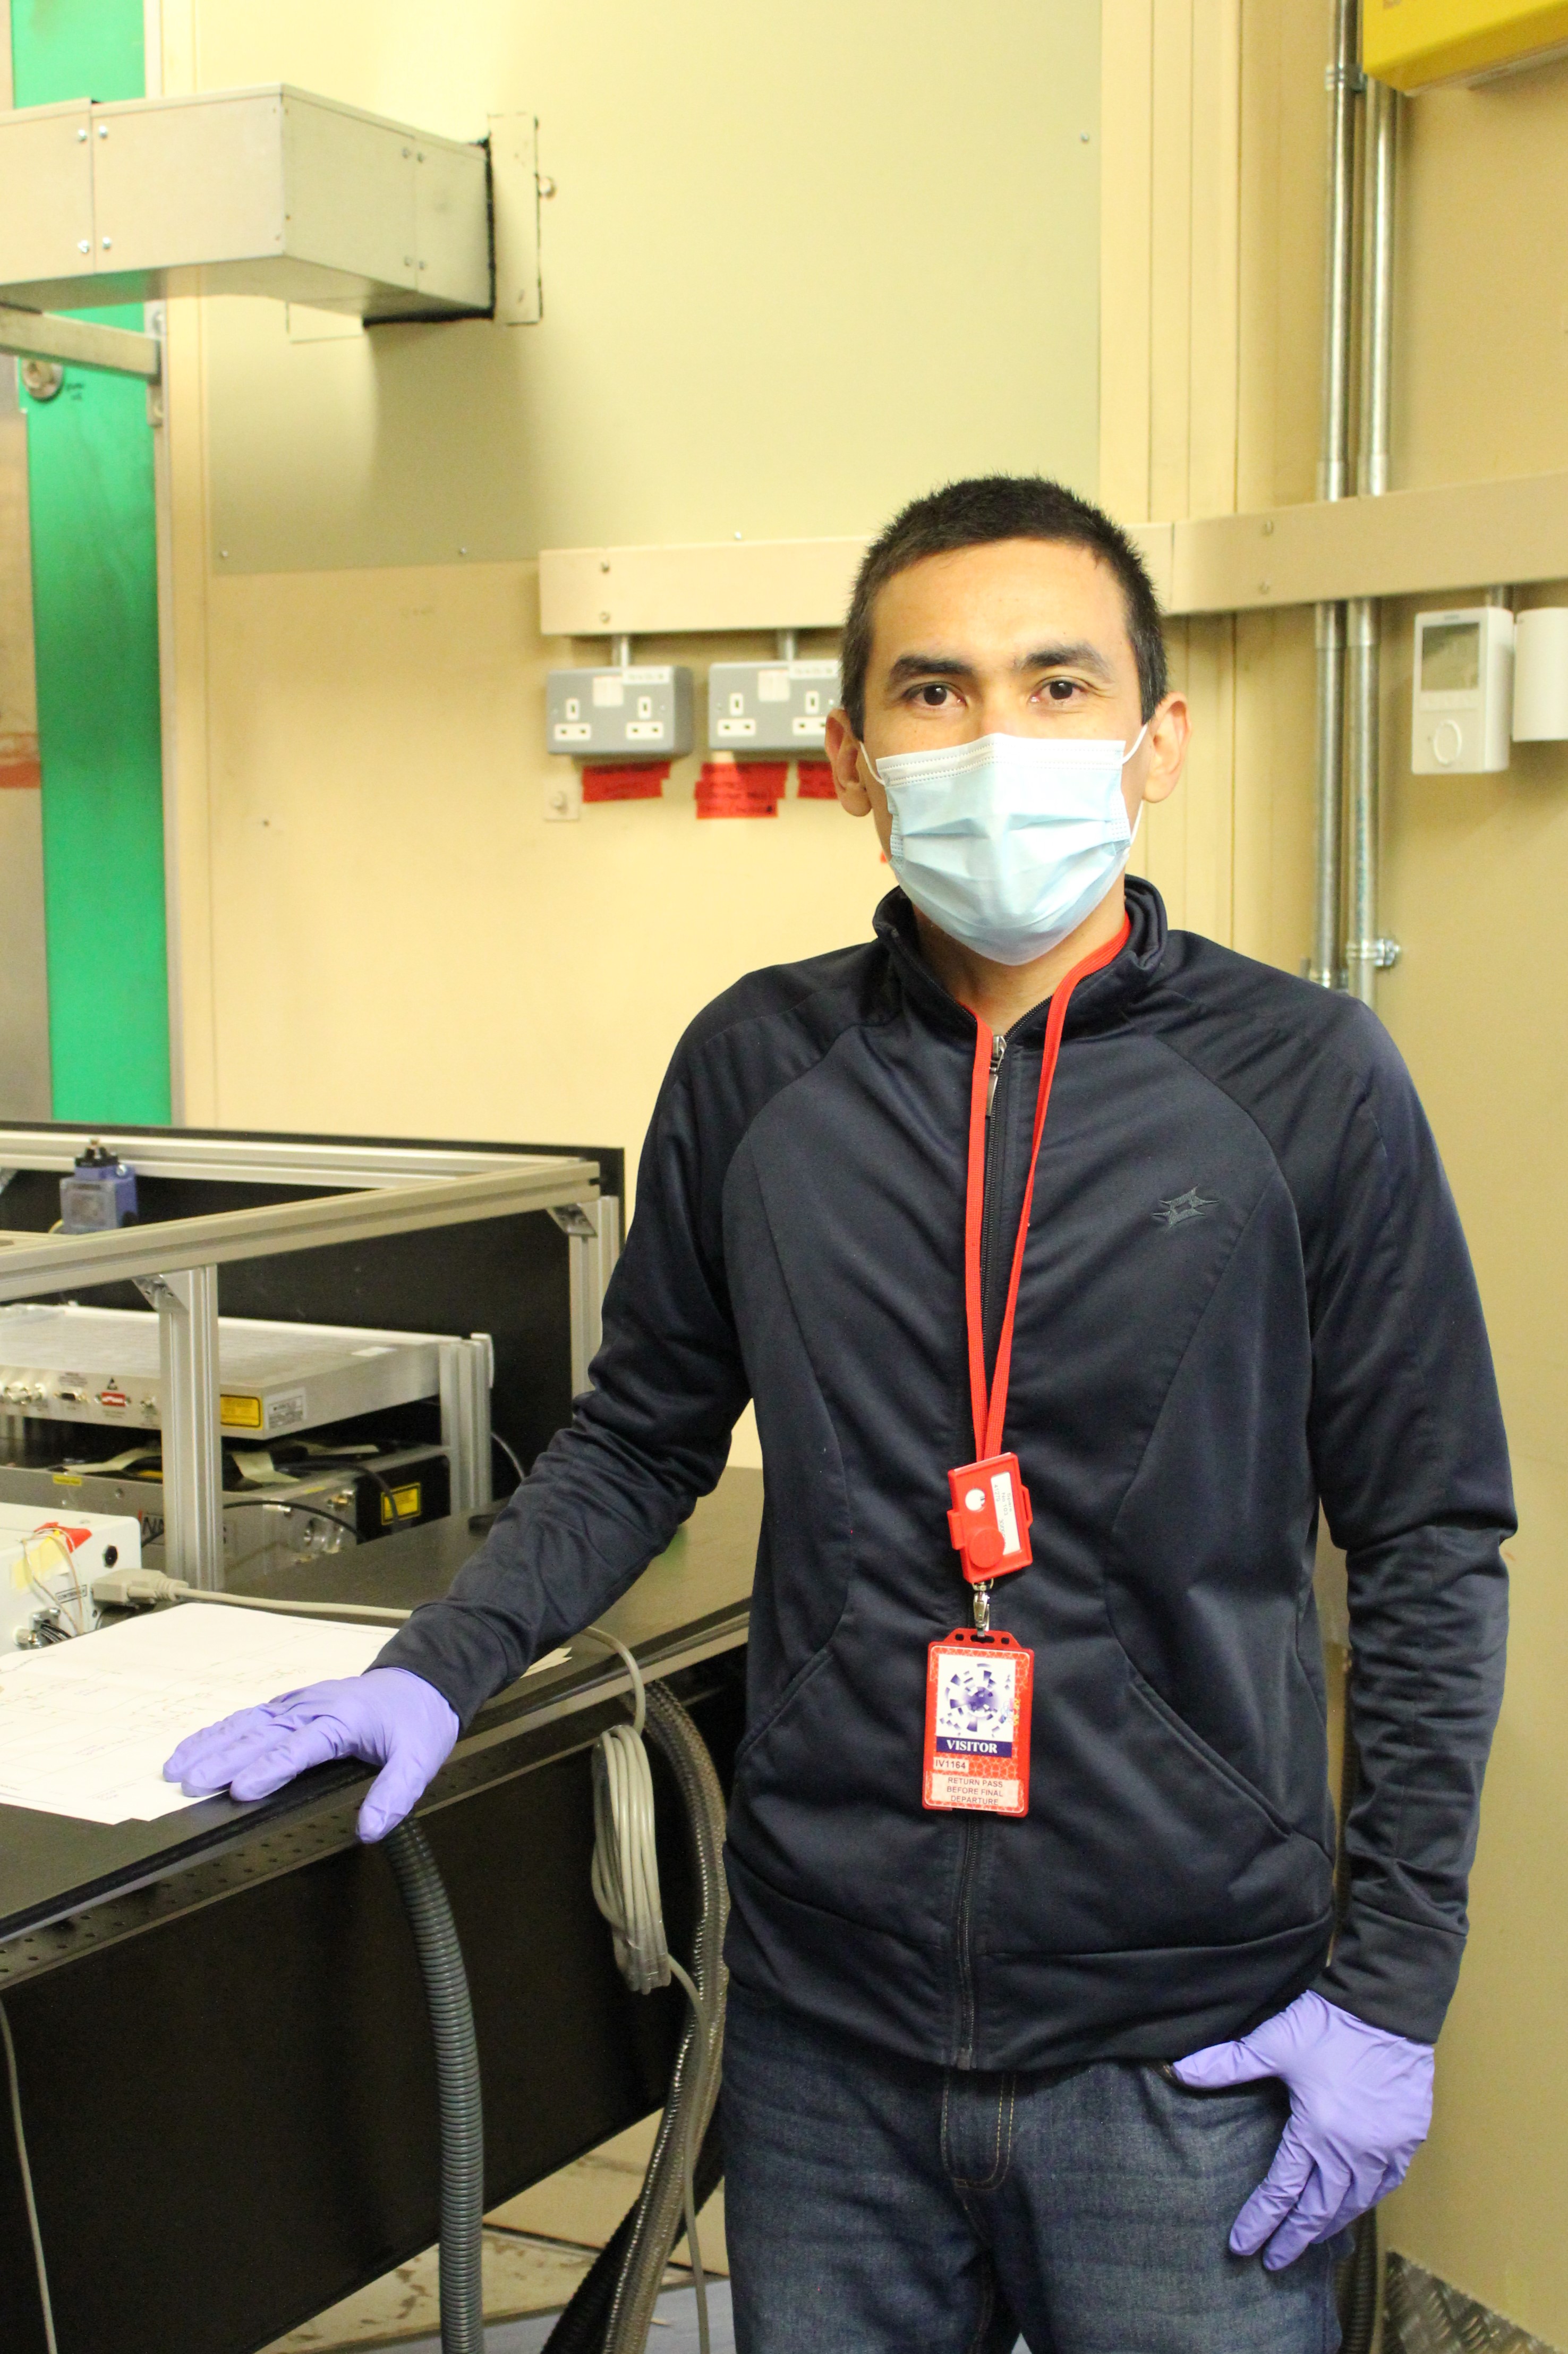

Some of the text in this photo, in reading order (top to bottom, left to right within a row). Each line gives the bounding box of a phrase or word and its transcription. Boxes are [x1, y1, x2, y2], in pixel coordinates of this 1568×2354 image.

[946, 1739, 998, 1753] VISITOR
[935, 1760, 966, 1769] IV1164
[947, 1786, 978, 1795] BEFORE
[951, 1796, 999, 1805] DEPARTURE
